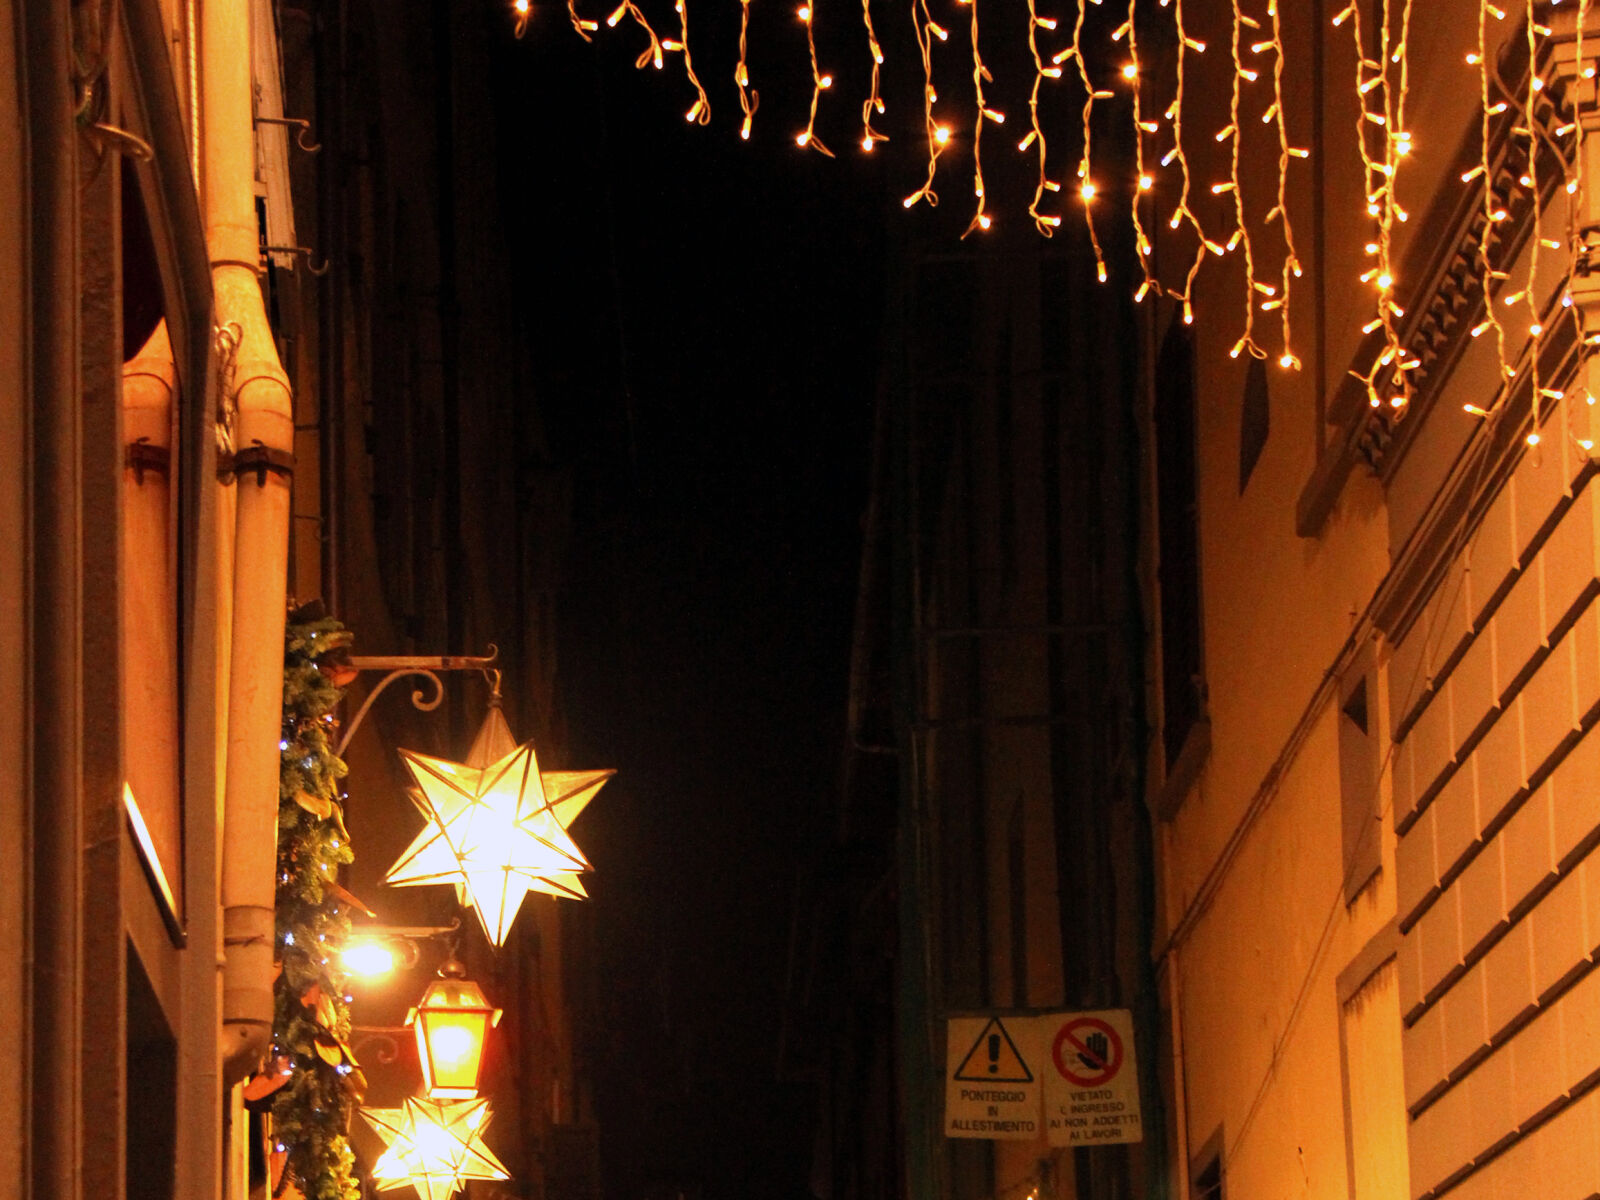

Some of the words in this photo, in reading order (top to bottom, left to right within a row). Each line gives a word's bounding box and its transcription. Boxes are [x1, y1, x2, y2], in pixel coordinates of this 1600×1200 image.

[960, 1089, 1026, 1103] PONTEGGIO
[1070, 1089, 1113, 1102] VIETATO
[987, 1106, 999, 1117] IN
[951, 1119, 1035, 1132] ALLESTIMENTO
[1050, 1118, 1061, 1128] AI
[1065, 1116, 1088, 1128] NON
[1093, 1114, 1139, 1126] ADDETTI
[1070, 1130, 1080, 1141] AI
[1084, 1128, 1122, 1140] LAVORI
